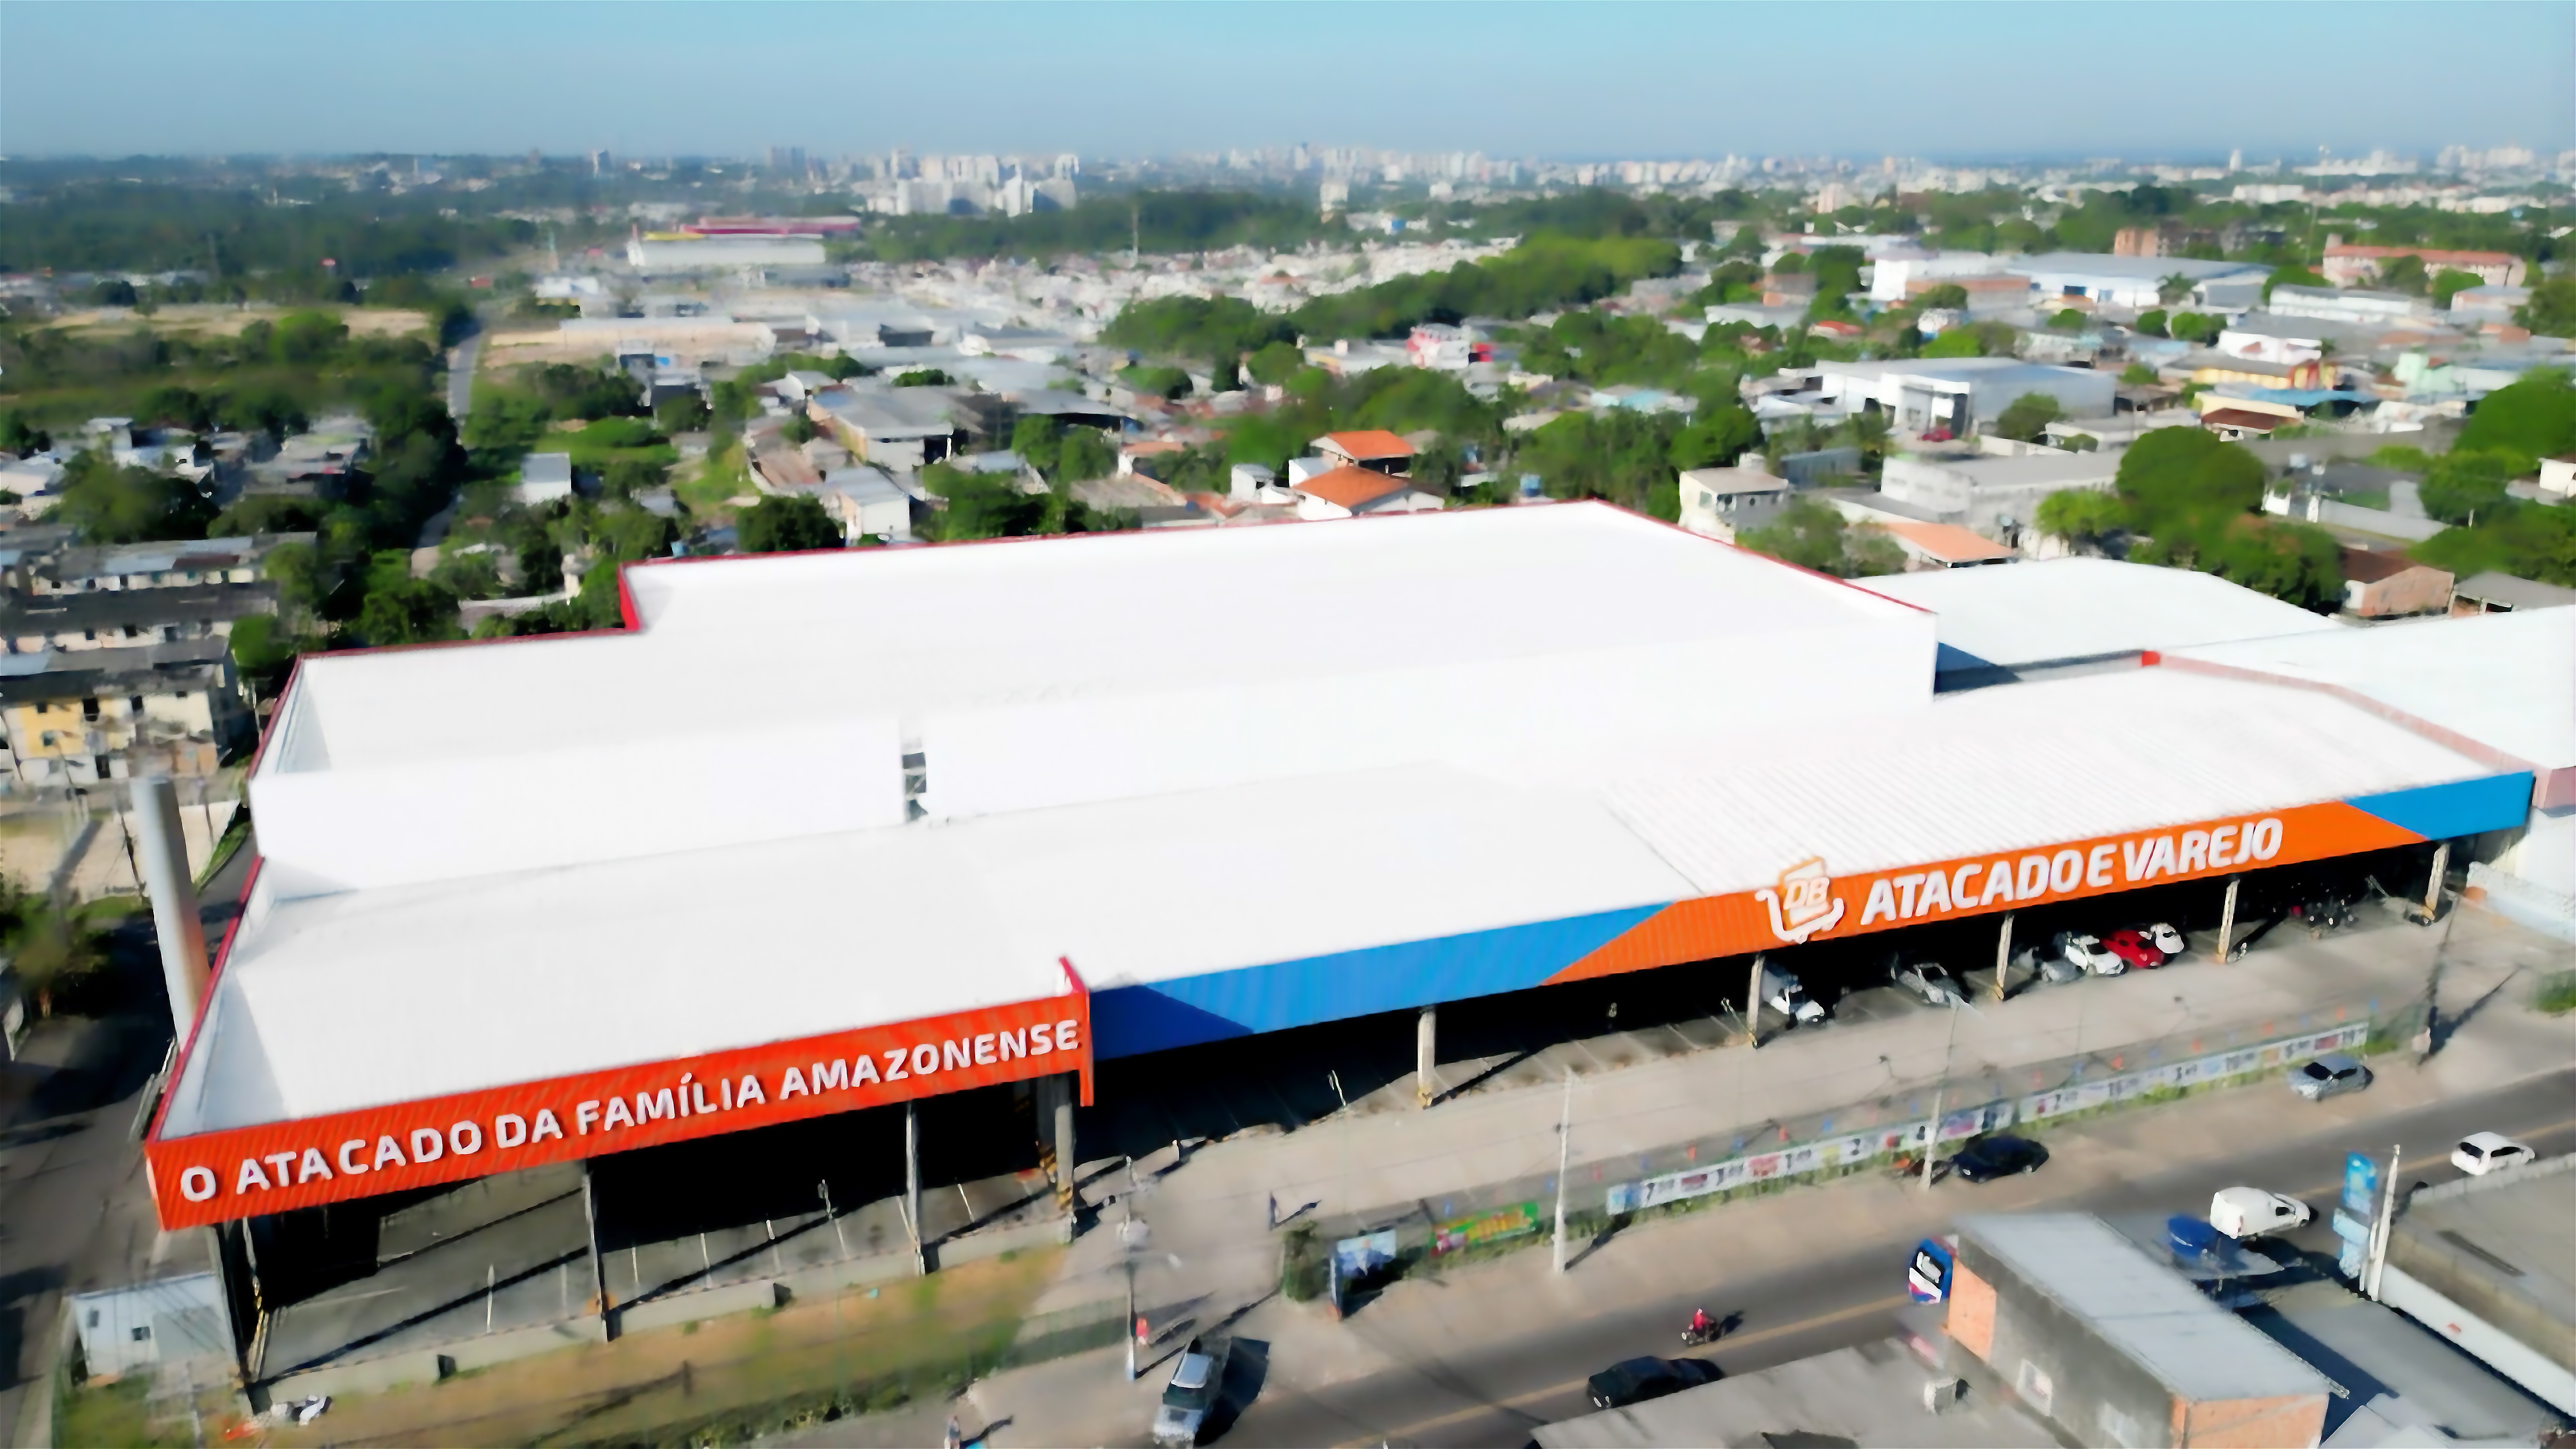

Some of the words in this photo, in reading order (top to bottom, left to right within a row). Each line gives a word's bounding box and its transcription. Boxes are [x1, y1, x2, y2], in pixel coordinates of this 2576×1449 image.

[1783, 877, 1830, 910] DB
[1860, 850, 2083, 925] ATACADO
[2086, 844, 2117, 887] E
[2124, 818, 2283, 881] VAREJO
[180, 1165, 217, 1202] O
[236, 1120, 482, 1194] ATACADO
[495, 1109, 563, 1148] DA
[576, 1072, 766, 1135] FAMÍLIA
[779, 1019, 1079, 1100] AMAZONENSE
